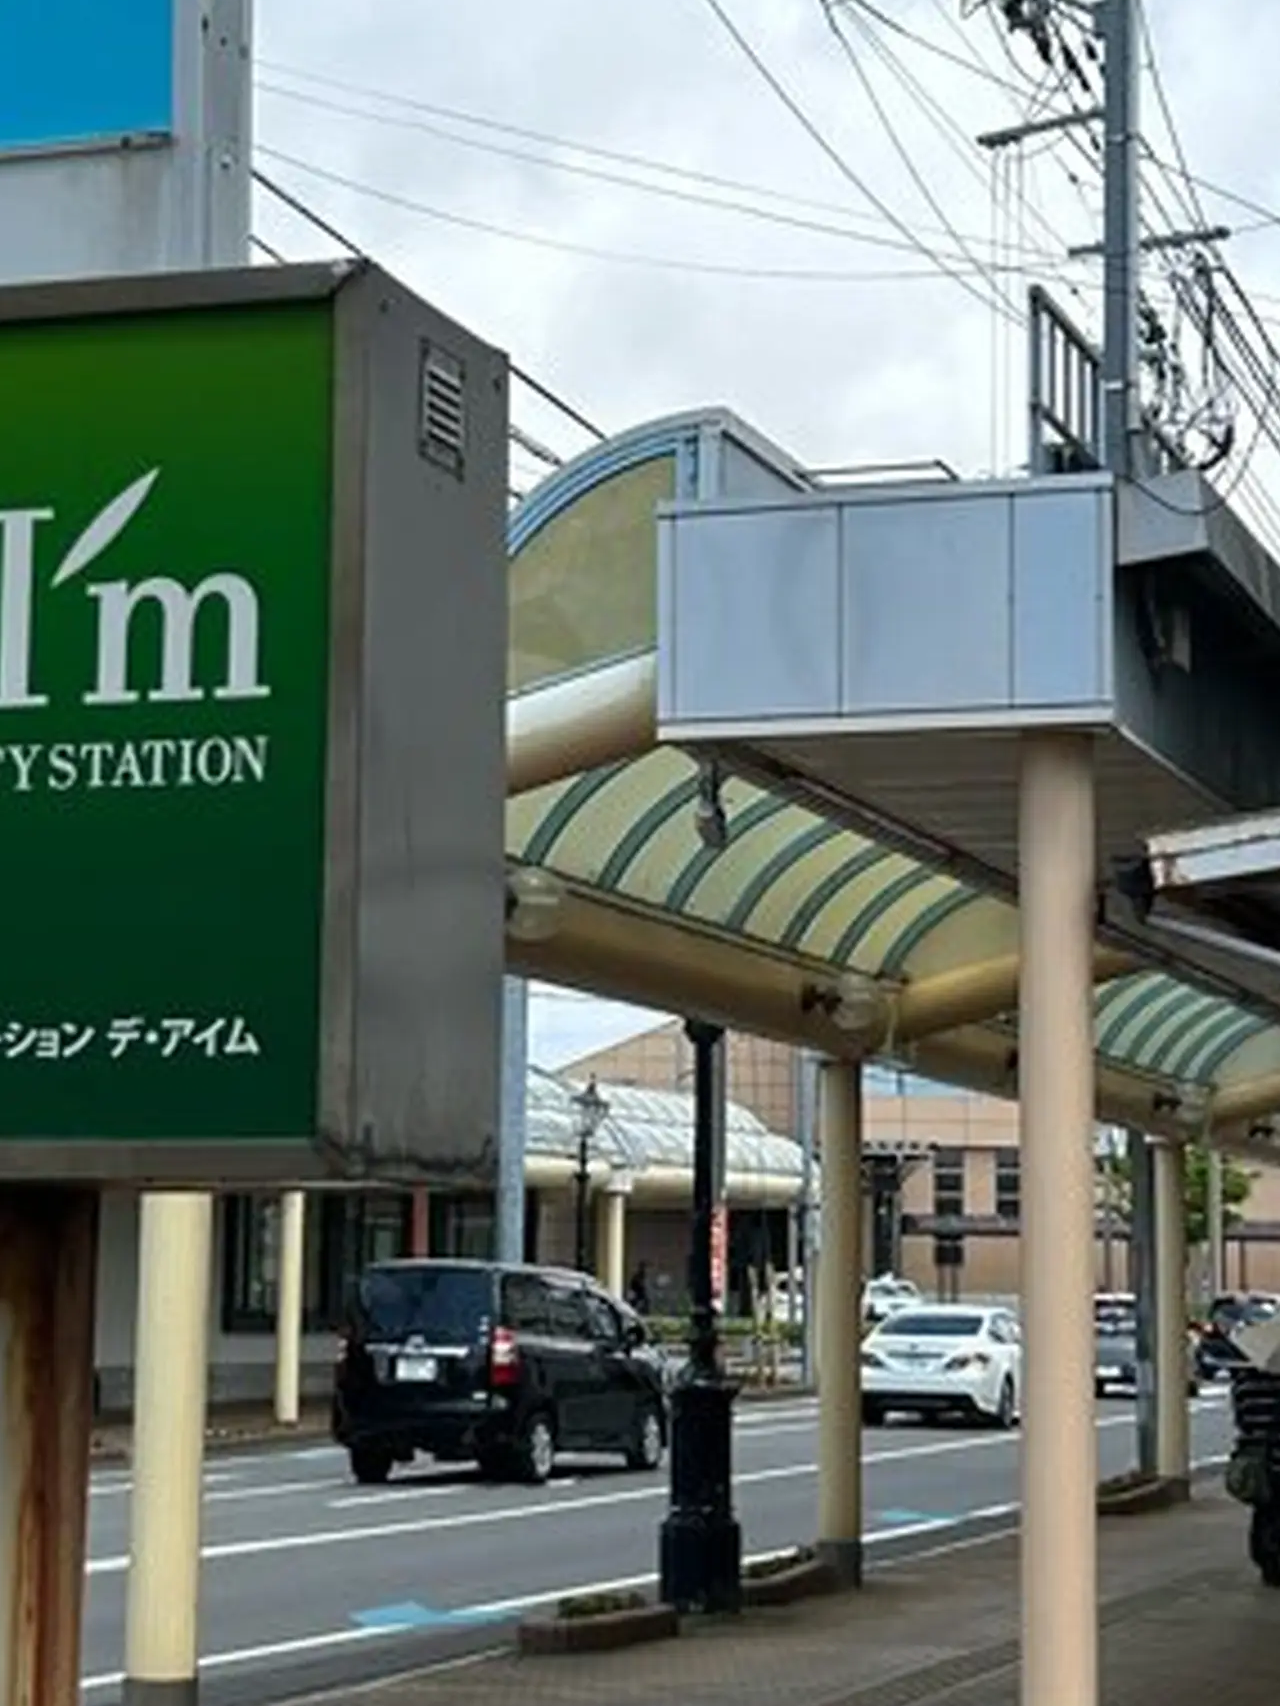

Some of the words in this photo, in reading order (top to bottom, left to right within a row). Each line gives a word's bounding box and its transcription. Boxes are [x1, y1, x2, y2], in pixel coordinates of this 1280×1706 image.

[47, 735, 269, 791] STATION
[106, 1016, 261, 1059] デ・アイム
